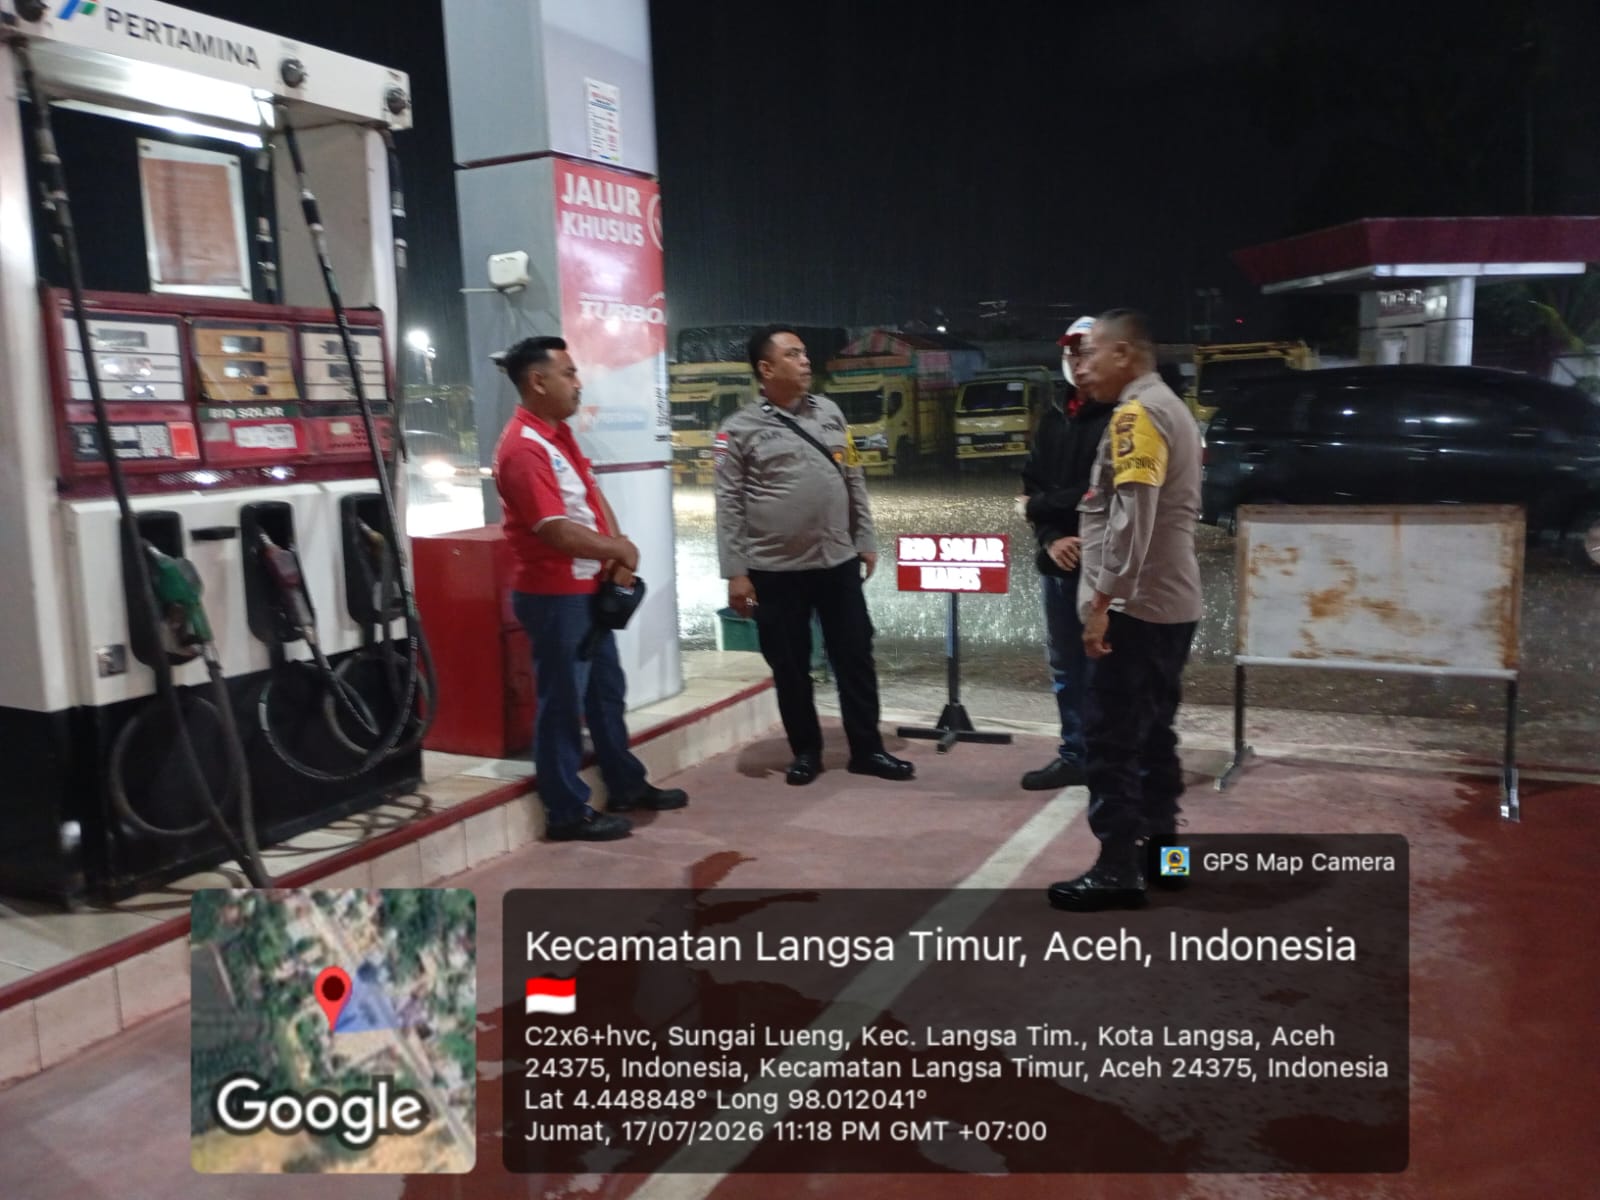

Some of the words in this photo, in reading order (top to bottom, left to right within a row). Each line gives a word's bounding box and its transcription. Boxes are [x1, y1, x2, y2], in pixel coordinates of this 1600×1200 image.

[104, 6, 261, 70] PERTAMINA
[561, 172, 643, 217] JALUR
[561, 210, 645, 247] KHUSUS
[578, 300, 666, 324] TURBO
[208, 407, 236, 420] BIO
[236, 406, 285, 419] SOLAR
